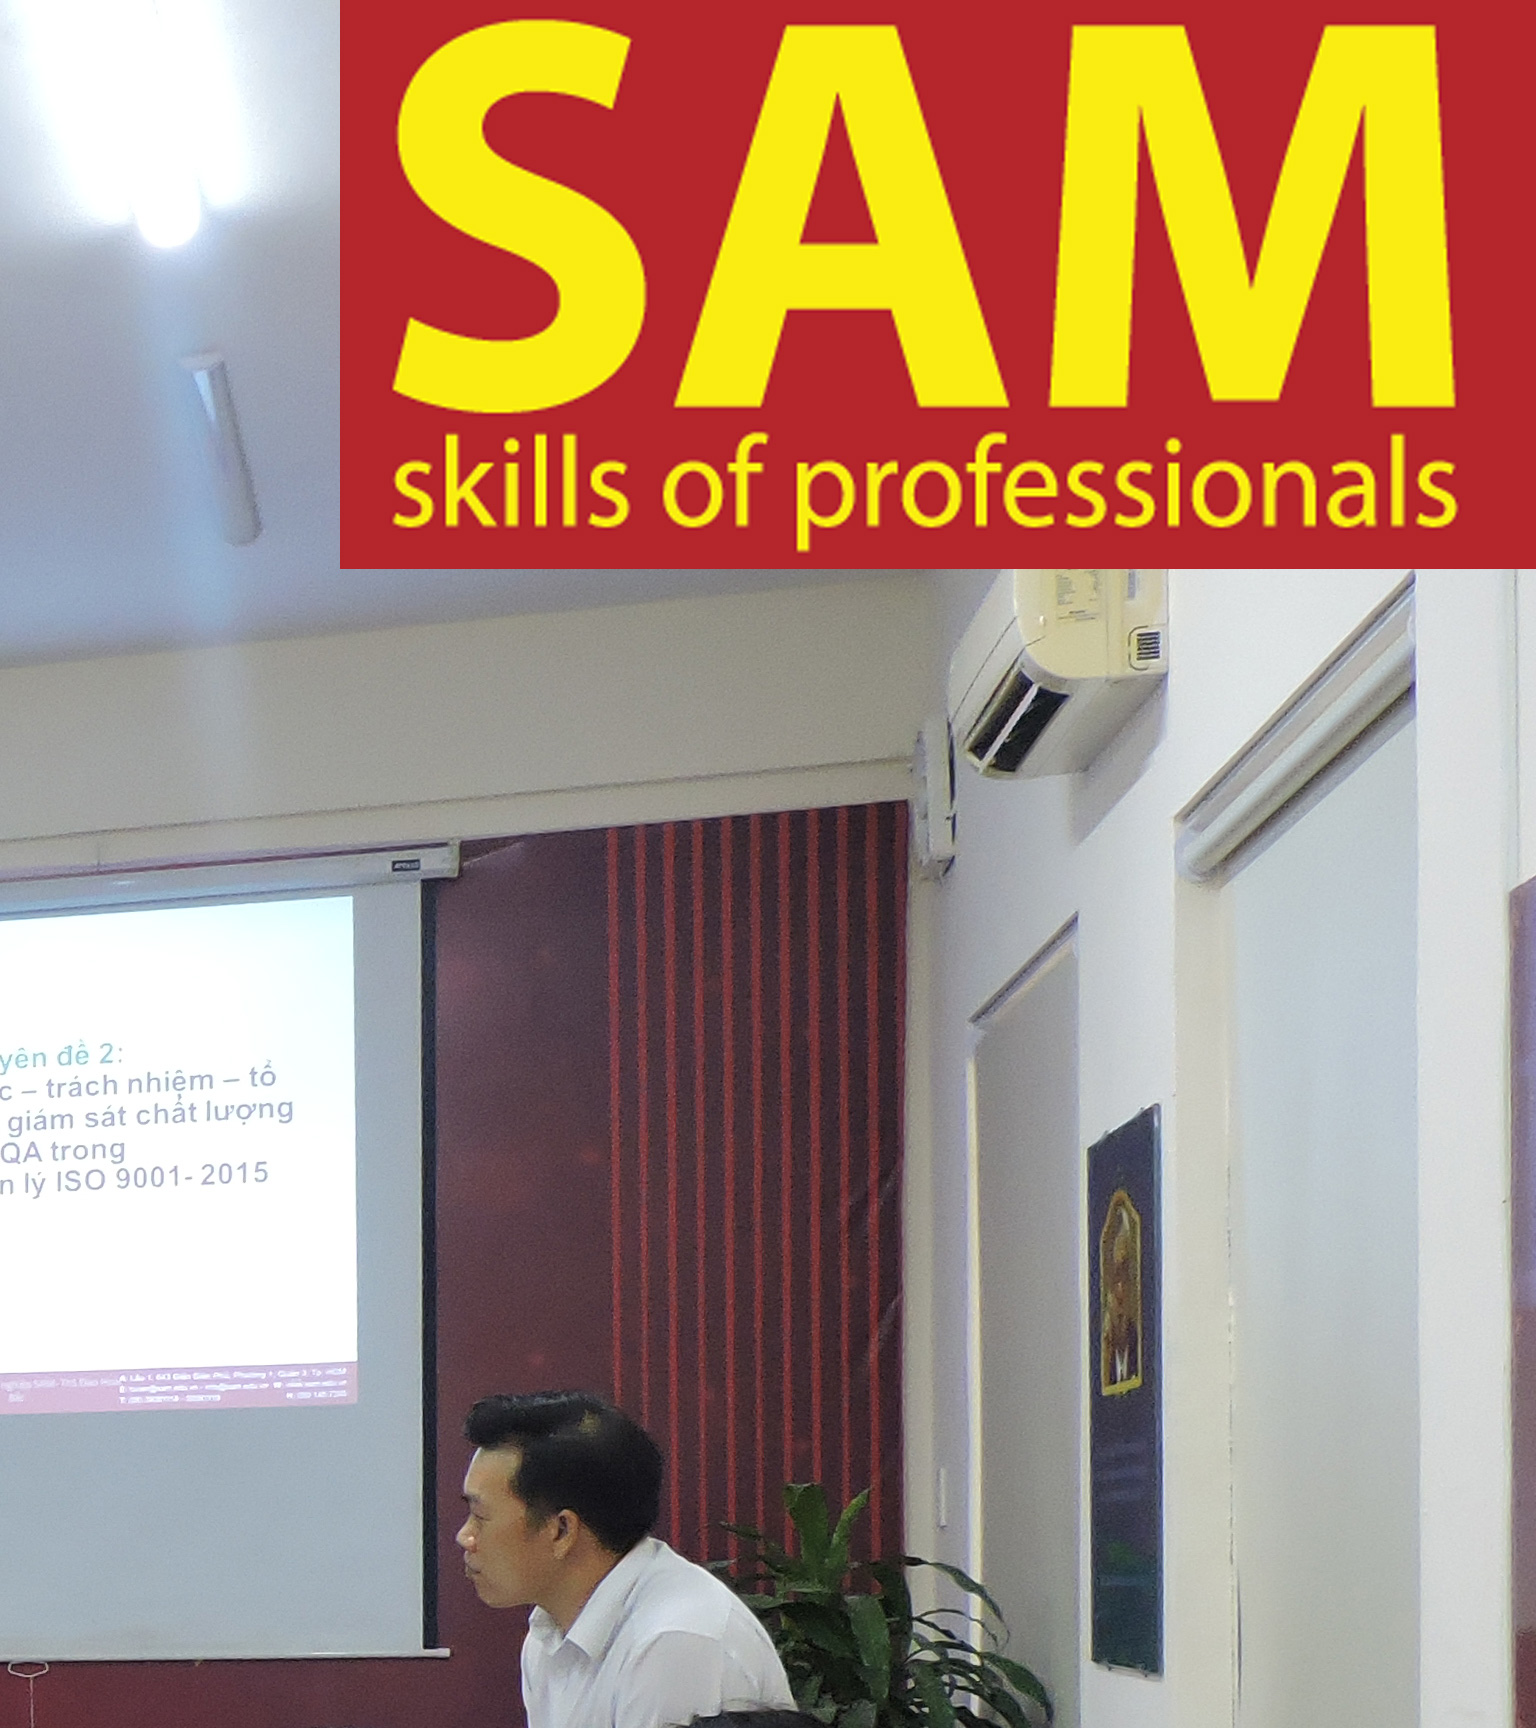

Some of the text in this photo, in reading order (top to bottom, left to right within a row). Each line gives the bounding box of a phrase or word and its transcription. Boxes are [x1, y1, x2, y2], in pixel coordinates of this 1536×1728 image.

[56, 1038, 90, 1067] đề
[98, 1042, 124, 1065] 2:
[45, 1074, 119, 1099] trách
[127, 1069, 215, 1099] nhiệm
[248, 1058, 277, 1088] tổ
[7, 1109, 75, 1138] giám
[84, 1104, 127, 1129] sát
[205, 1099, 295, 1127] lượng
[0, 1140, 43, 1166] QA
[50, 1140, 126, 1165] trong
[24, 1171, 47, 1200] lý
[56, 1168, 106, 1193] ISO
[200, 1160, 270, 1187] 2015
